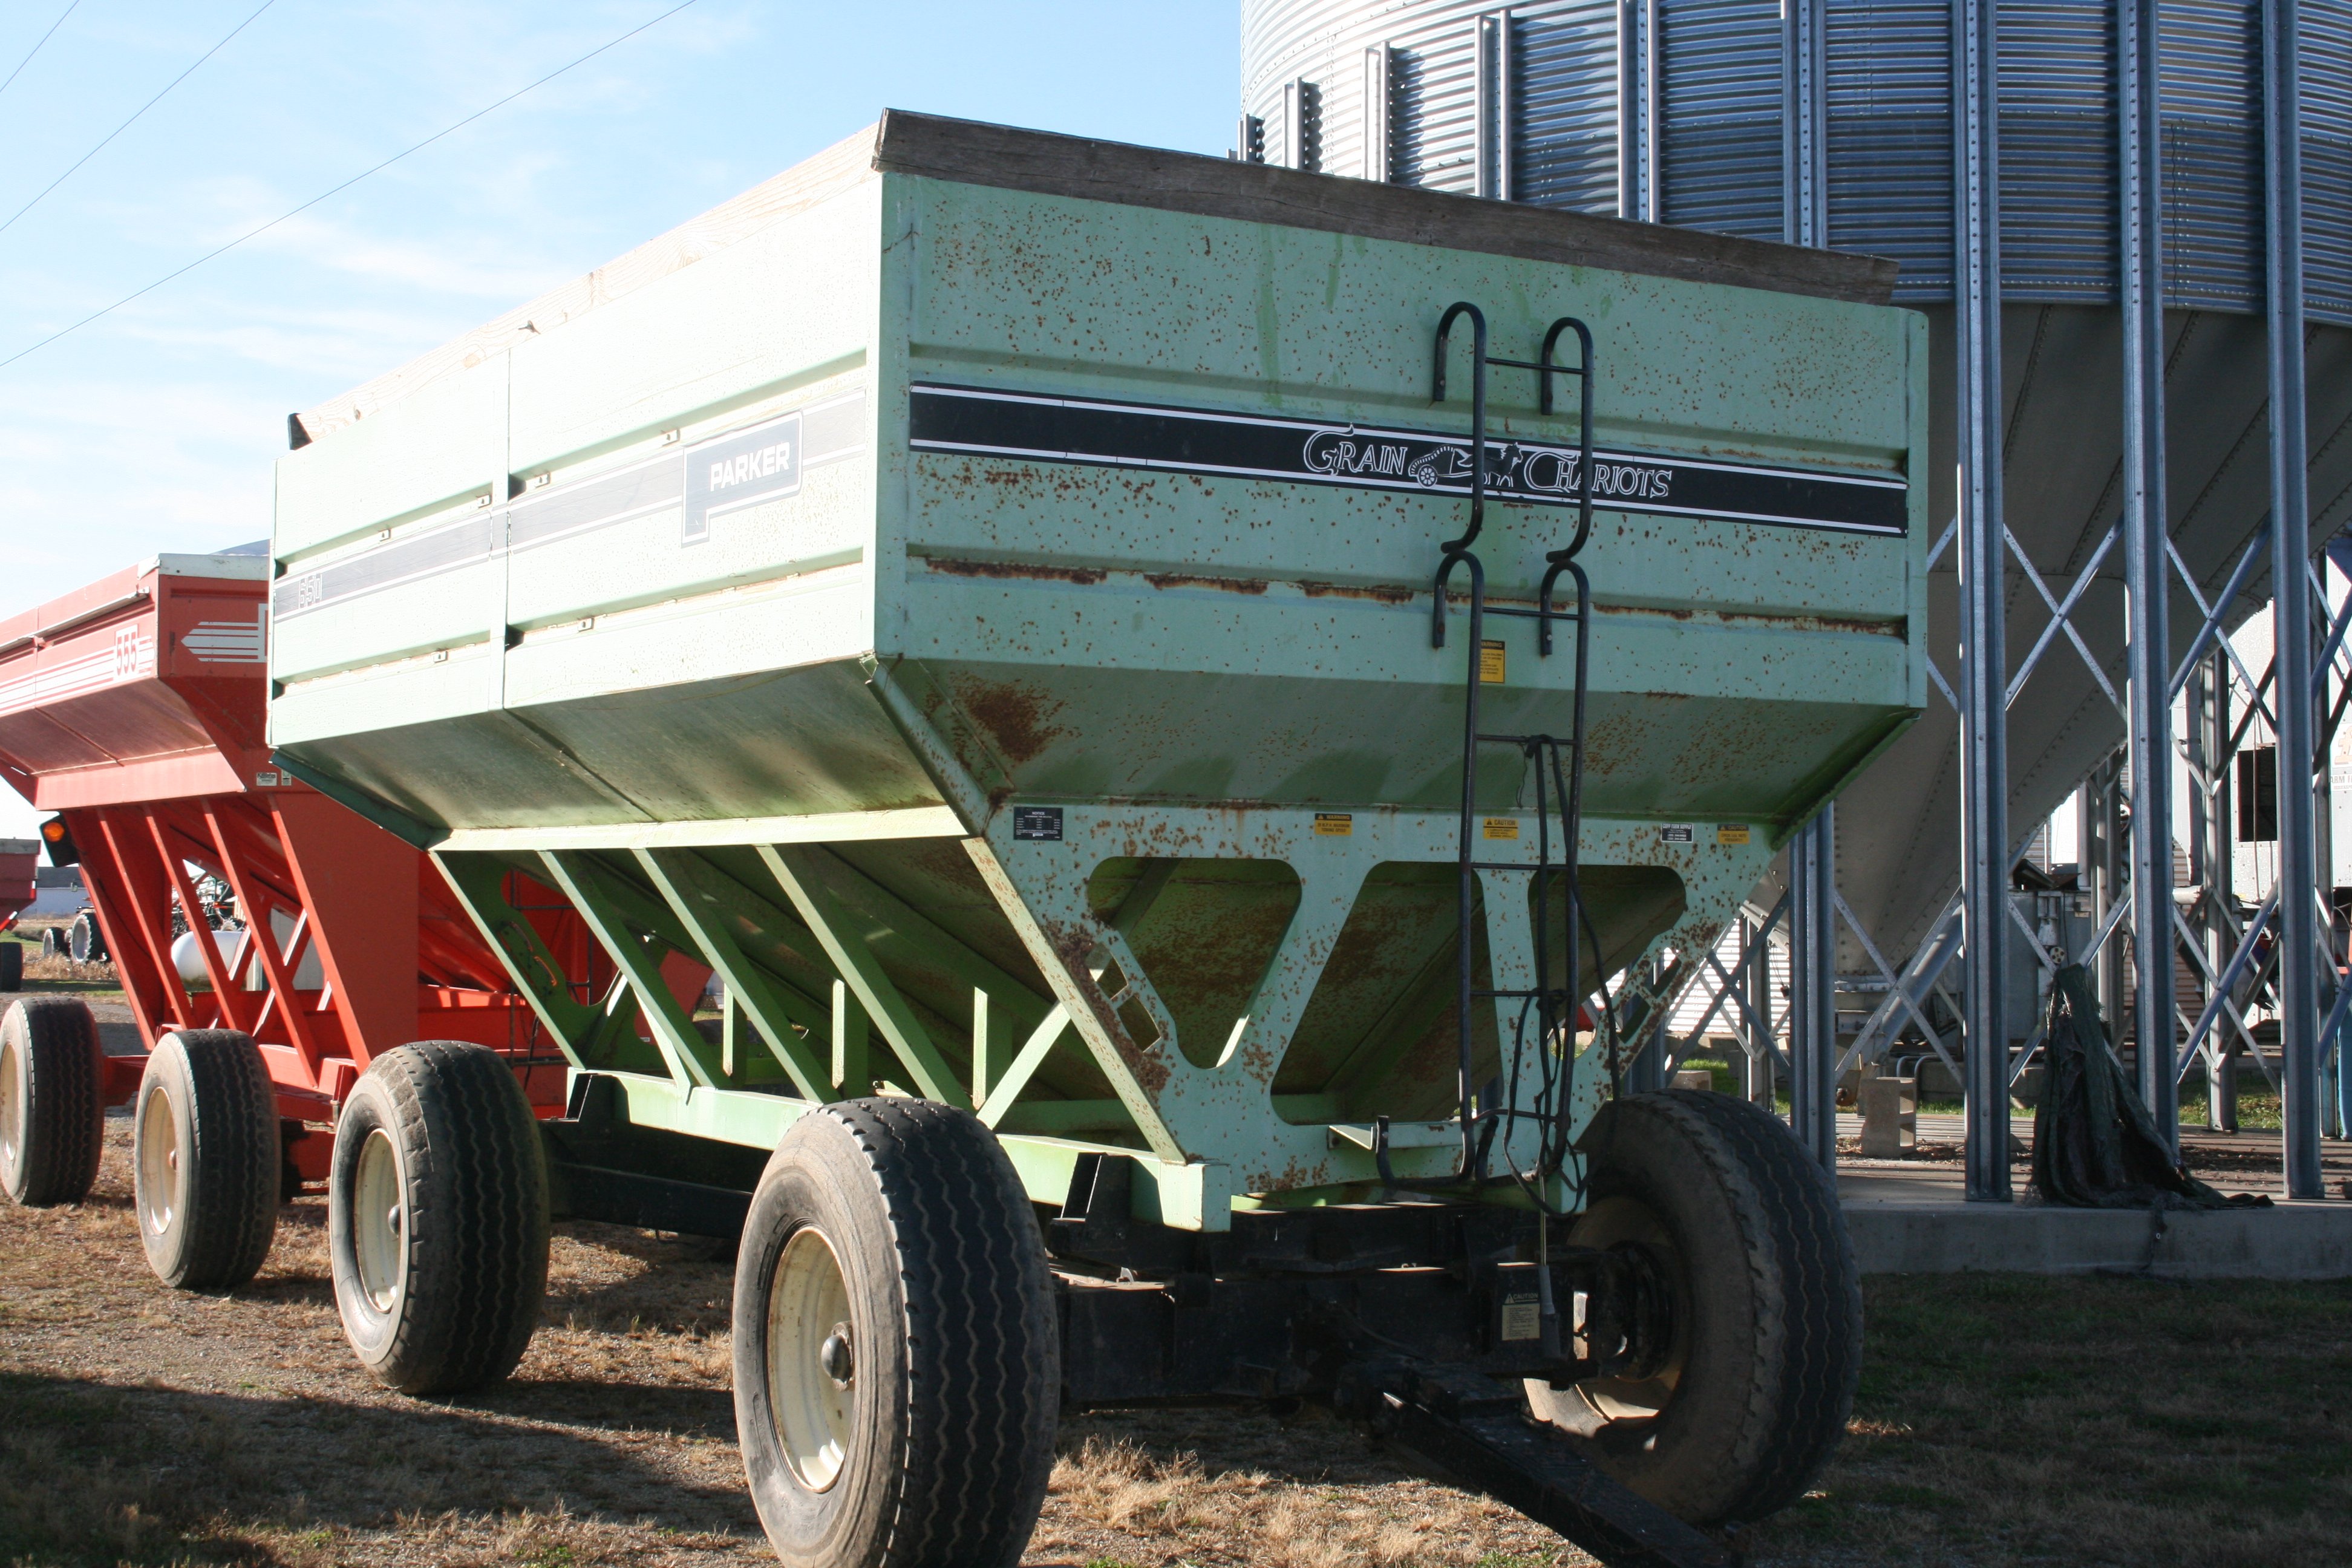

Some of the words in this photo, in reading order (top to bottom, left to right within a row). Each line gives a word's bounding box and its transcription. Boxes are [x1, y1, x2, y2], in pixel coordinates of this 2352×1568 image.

[710, 442, 791, 492] PARKER
[1303, 422, 1408, 476] GRAIN
[298, 573, 323, 609] 650
[116, 631, 137, 676] 555
